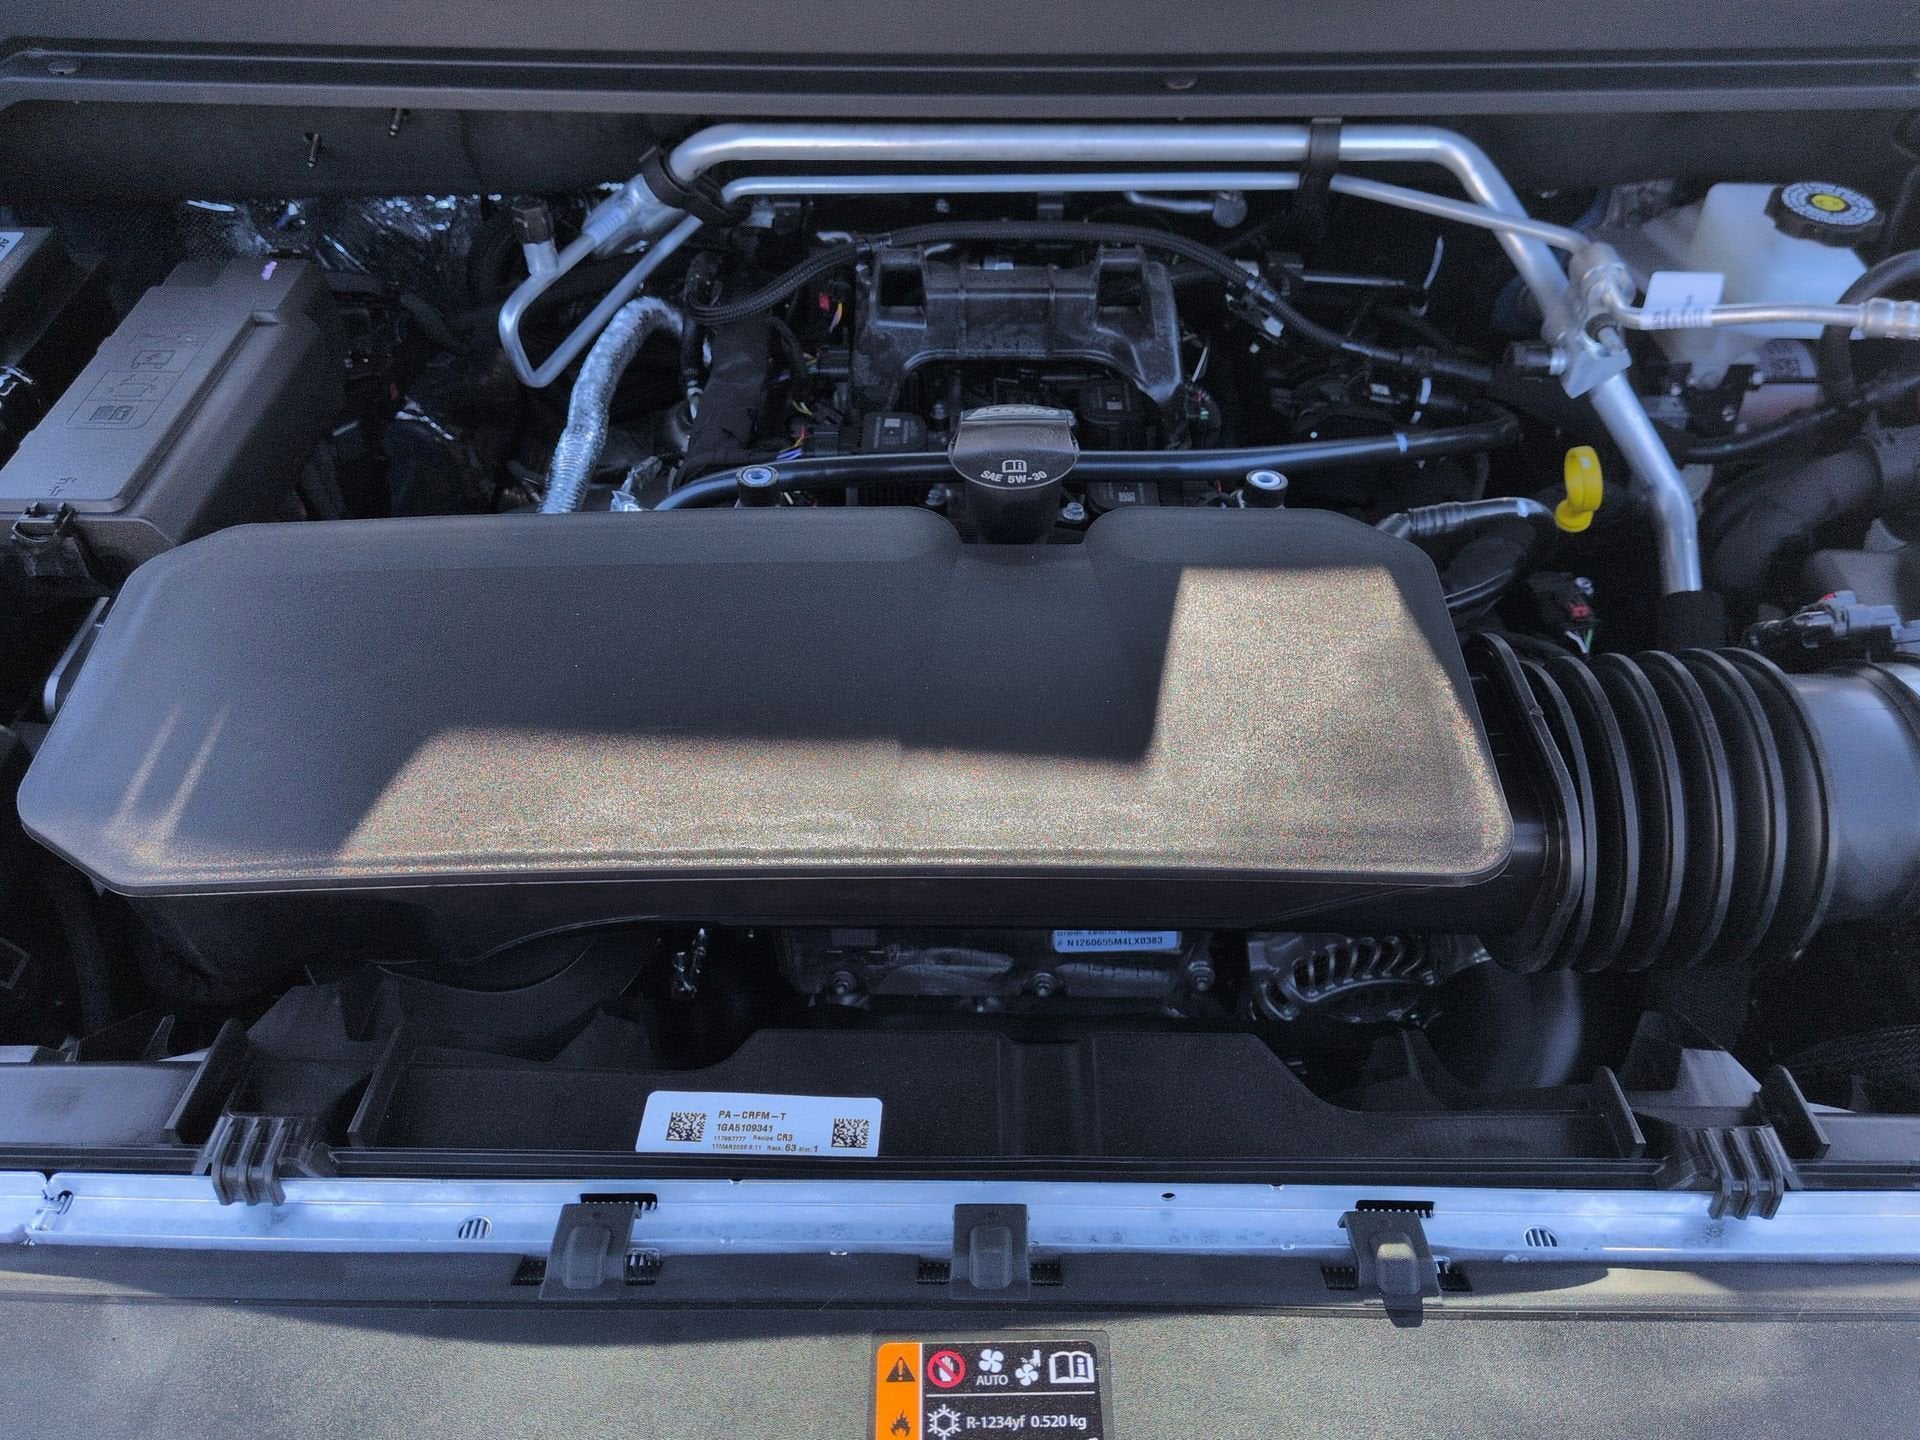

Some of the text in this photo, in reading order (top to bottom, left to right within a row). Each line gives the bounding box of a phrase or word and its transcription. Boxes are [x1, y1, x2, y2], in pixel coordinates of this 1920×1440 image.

[980, 470, 1048, 484] SAE 5W-30
[716, 1123, 773, 1133] 1GA5109341
[776, 1133, 794, 1142] CR3
[784, 1144, 797, 1152] 63
[976, 1374, 1009, 1386] AUTO
[966, 1414, 1087, 1431] R-1234yf 0.520 kg
